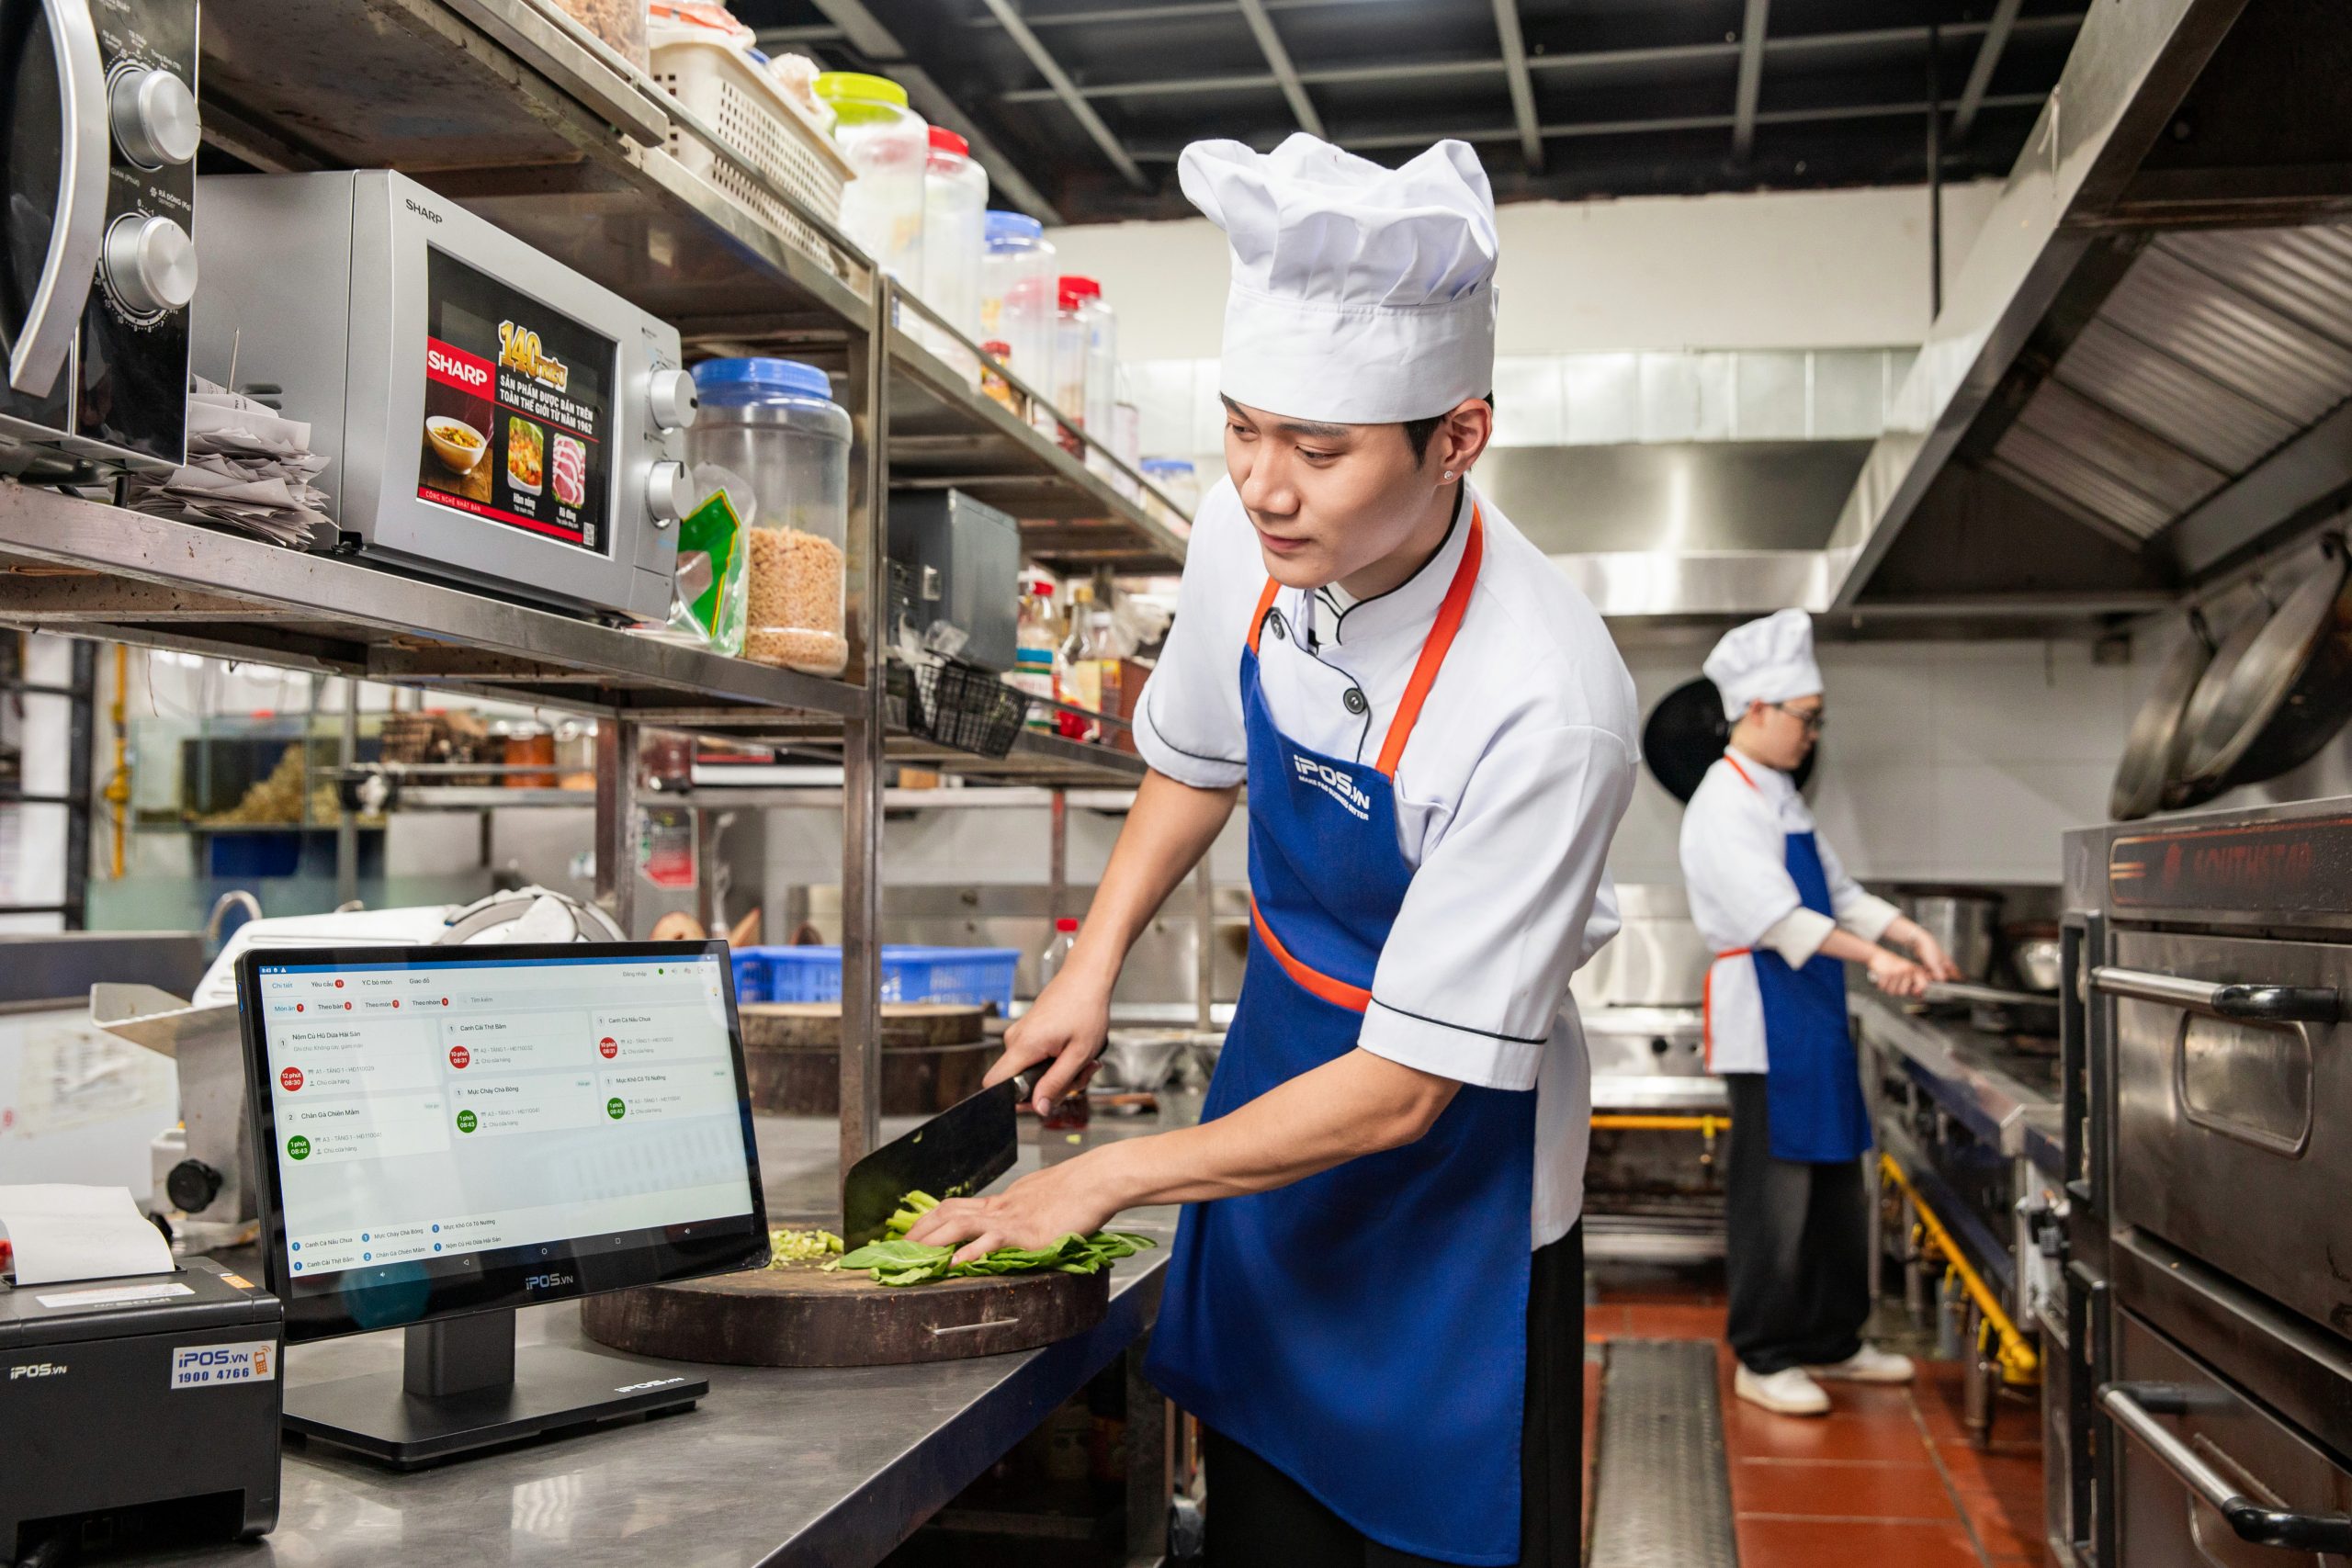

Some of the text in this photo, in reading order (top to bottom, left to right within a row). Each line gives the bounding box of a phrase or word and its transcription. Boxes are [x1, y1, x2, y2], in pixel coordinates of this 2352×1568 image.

[406, 198, 443, 224] SHARP
[499, 321, 542, 378] 140
[427, 350, 488, 387] SHARP
[500, 374, 594, 422] SẢN PHẨM ĐƯỢC BÁN TRÊN
[500, 389, 593, 434] TOÀN THẾ GIỚI TỪ NĂM 1962
[1349, 804, 1369, 821] BETTER
[526, 1273, 573, 1291] iPOS.VN
[178, 1349, 248, 1368] iPOS.VN
[9, 1363, 67, 1380] iPOS.VN
[178, 1367, 250, 1383] 1900 4766
[614, 1377, 684, 1393] iPOS.VN
